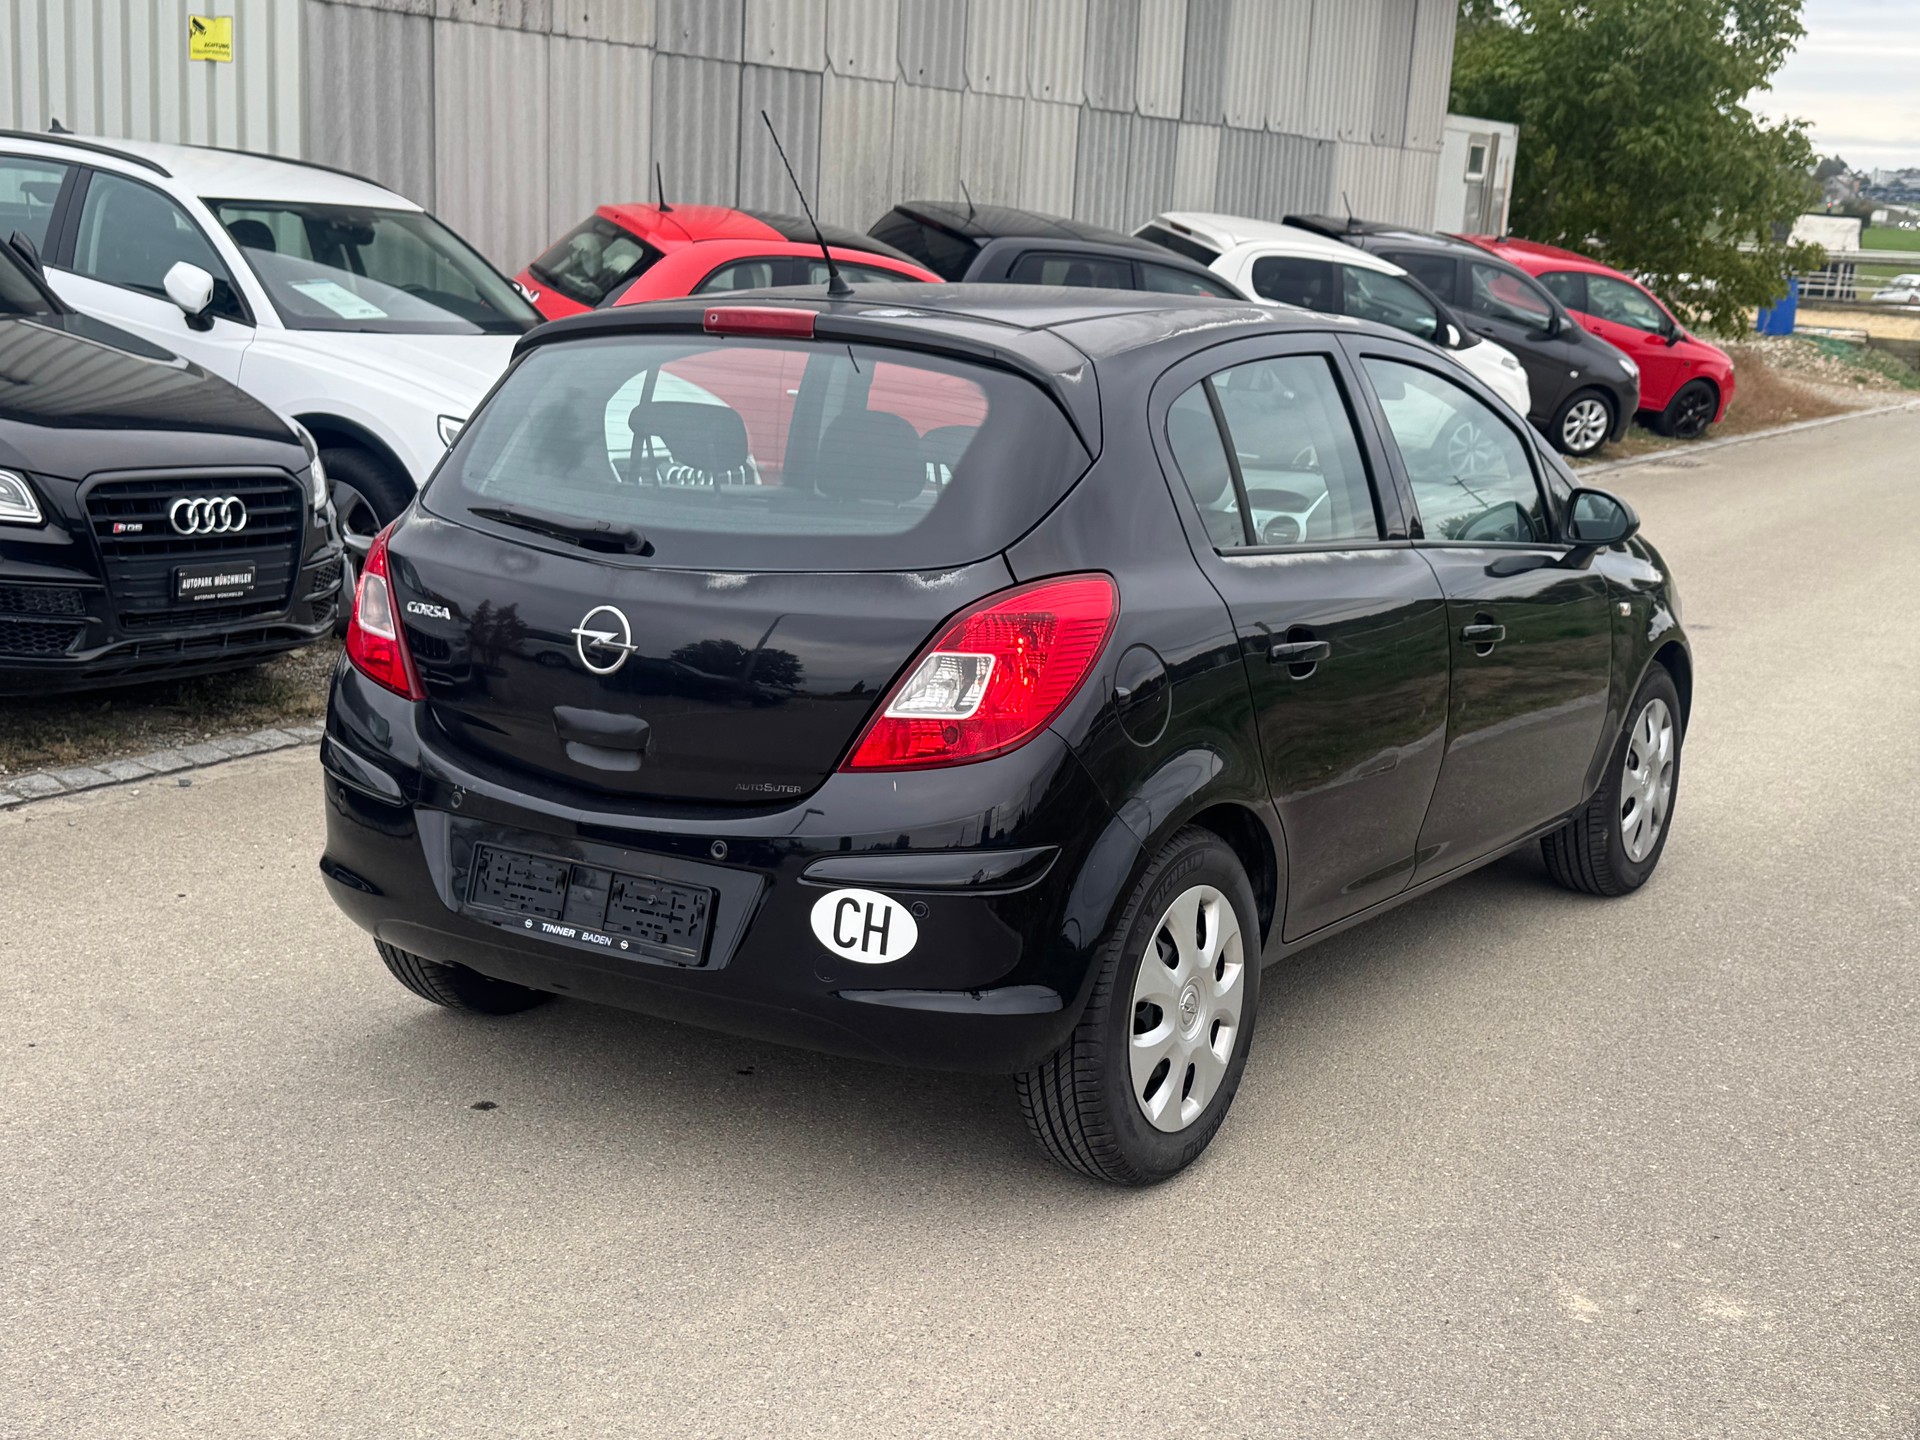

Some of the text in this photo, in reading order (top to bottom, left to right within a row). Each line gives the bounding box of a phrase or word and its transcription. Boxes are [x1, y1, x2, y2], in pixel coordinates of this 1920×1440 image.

[182, 576, 213, 590] AUTOPARK
[407, 601, 451, 620] CORSA
[1149, 850, 1204, 917] MICHELIN
[541, 923, 612, 946] TINNER BADEN
[833, 897, 892, 956] CH
